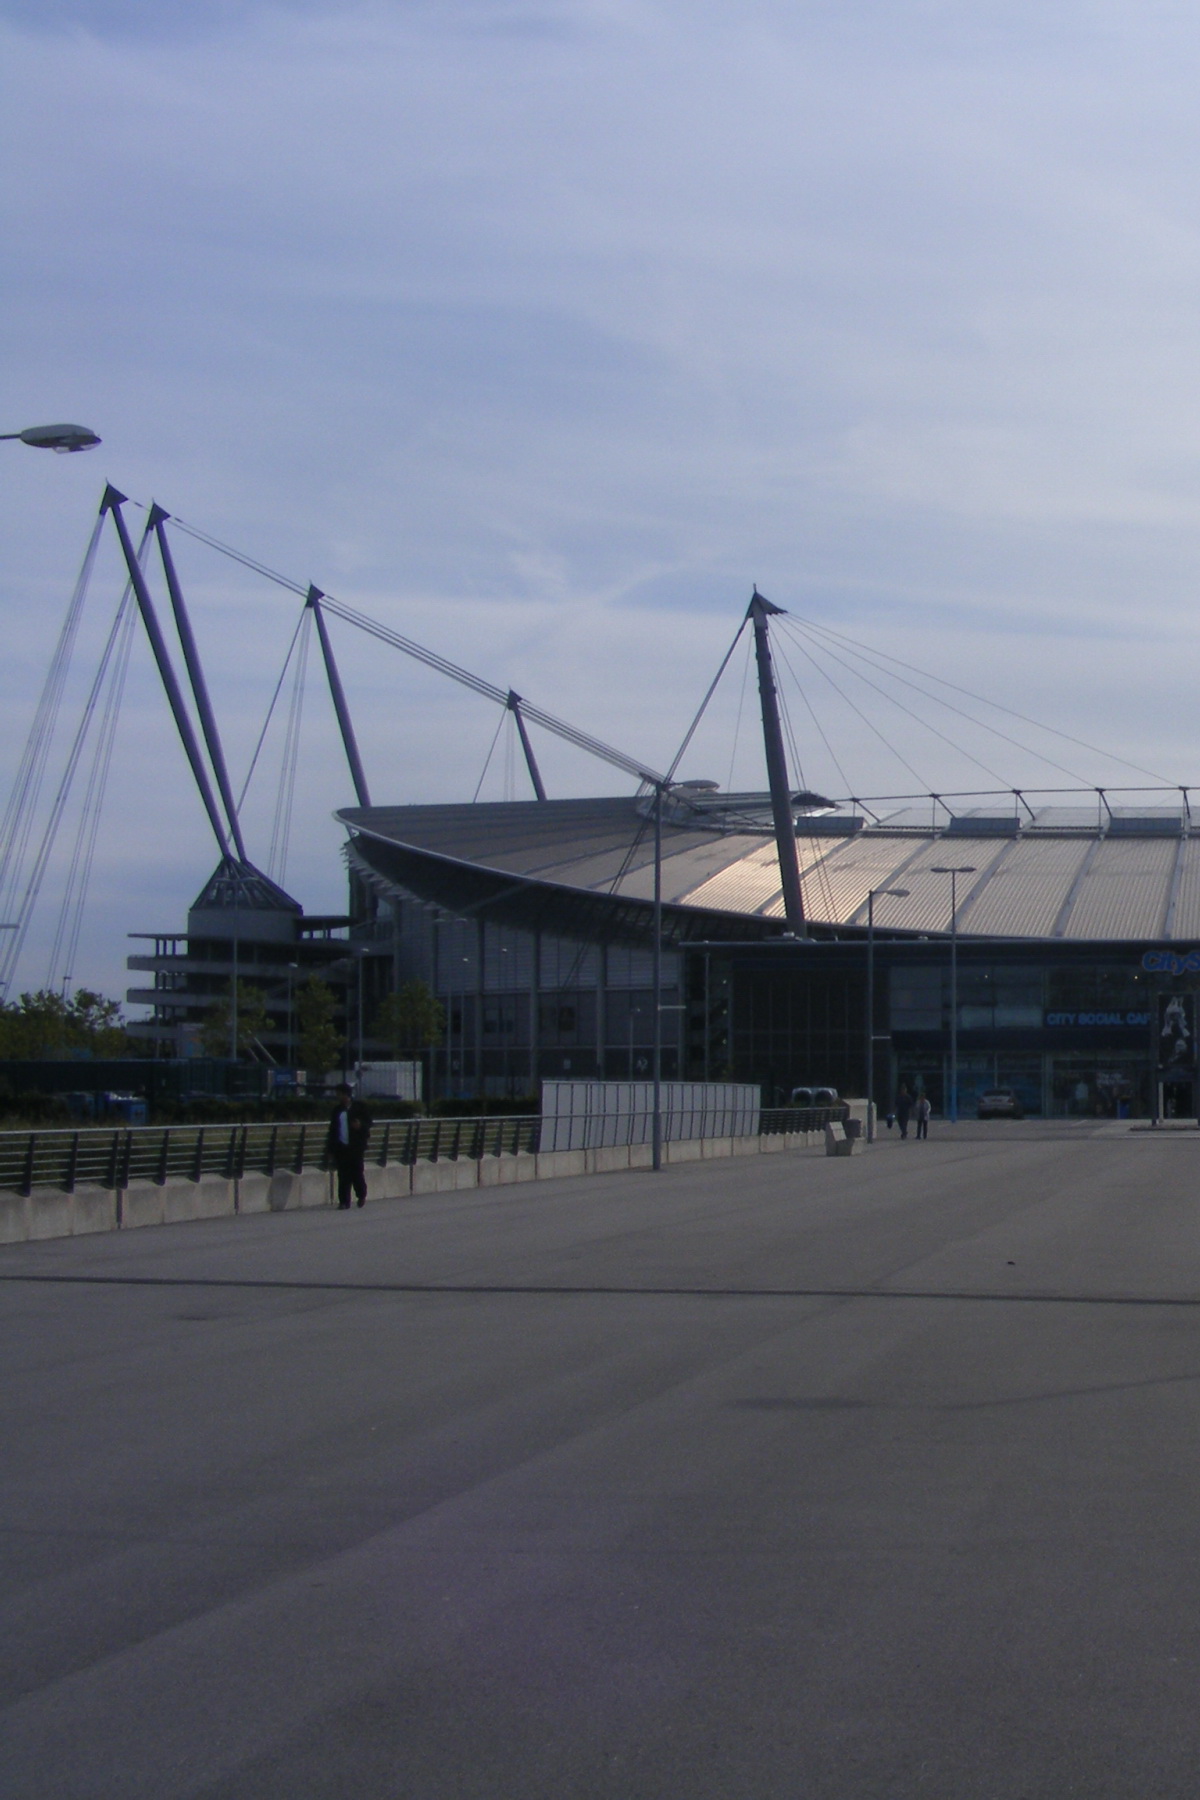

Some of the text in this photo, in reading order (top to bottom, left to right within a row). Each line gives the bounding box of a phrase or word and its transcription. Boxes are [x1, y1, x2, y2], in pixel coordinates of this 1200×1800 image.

[1047, 1012, 1075, 1025] CITY
[1078, 1012, 1124, 1025] SOCIAL
[1127, 1012, 1152, 1025] CAF
